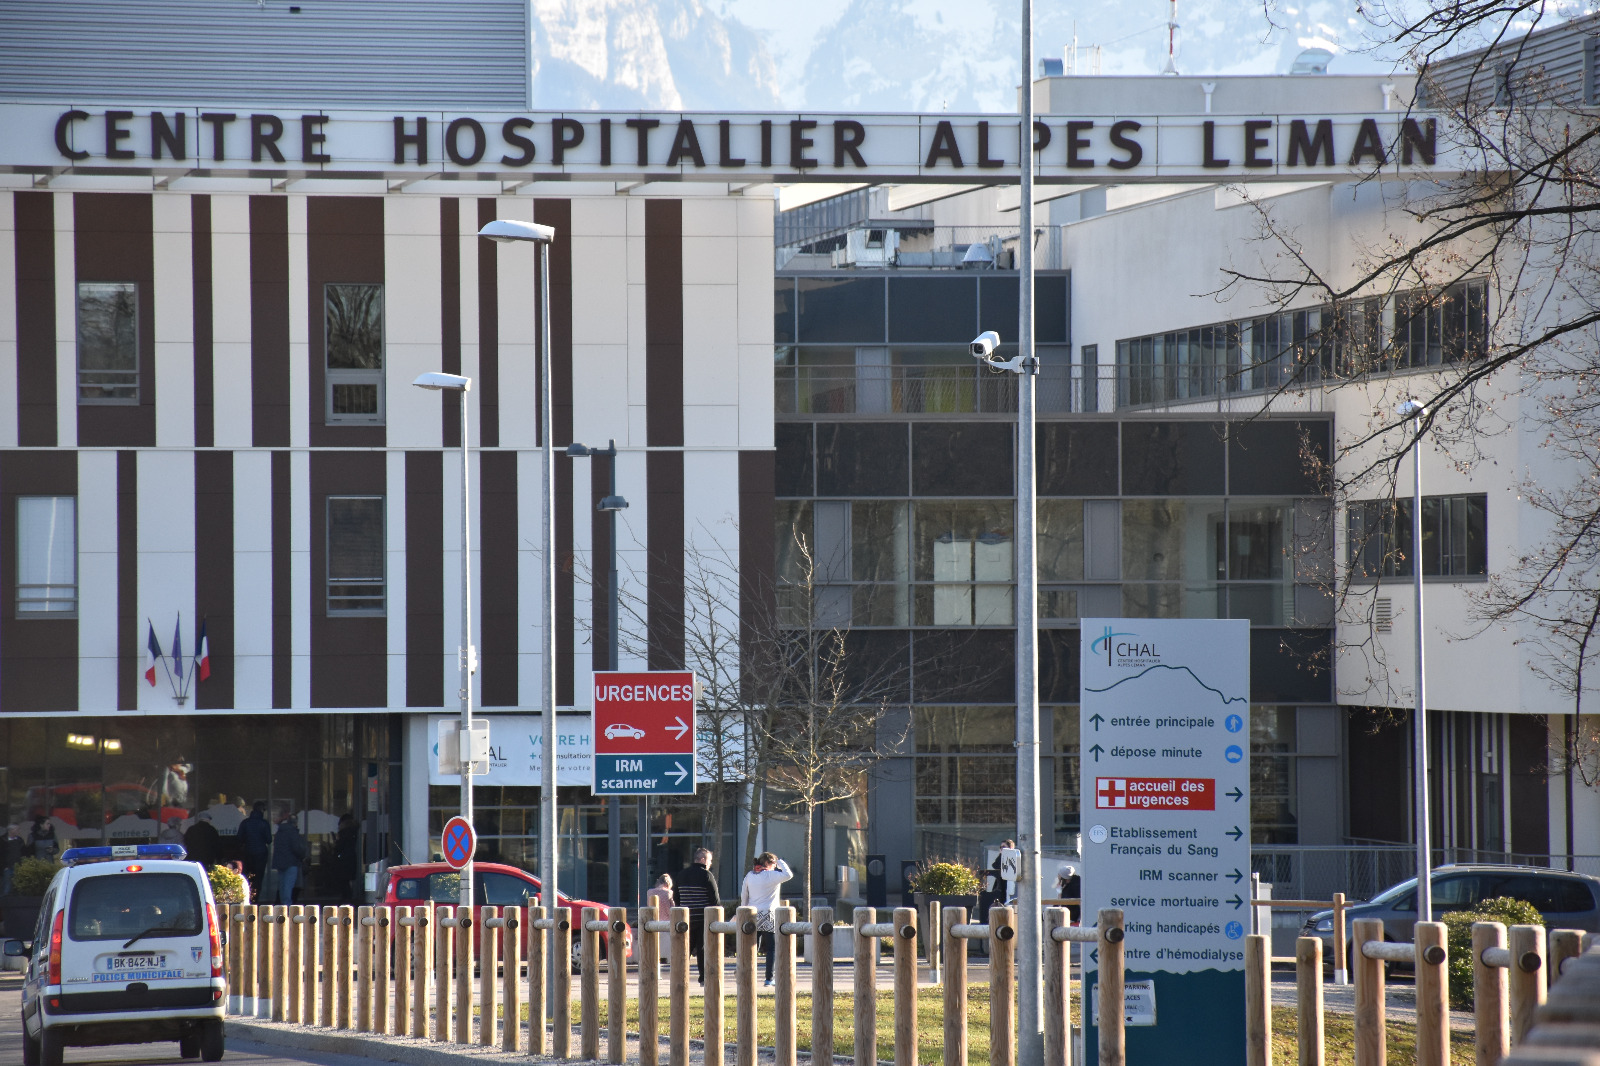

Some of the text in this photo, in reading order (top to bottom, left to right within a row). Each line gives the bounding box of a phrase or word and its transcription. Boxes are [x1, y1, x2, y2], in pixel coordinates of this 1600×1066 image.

[54, 110, 1437, 170] CENTRE HOSPITALIER ALPES LEMAN
[1116, 642, 1161, 657] CHAL
[595, 684, 693, 702] URGENCES
[1110, 715, 1215, 729] entrée principale
[529, 734, 576, 746] VRE
[1110, 746, 1203, 759] dépose minute
[615, 759, 643, 772] IRM
[601, 778, 658, 789] scanner
[1129, 780, 1205, 792] accueil des
[1129, 795, 1190, 807] urgences
[1110, 827, 1198, 839] Etablissement
[1110, 843, 1219, 858] Français du Sang
[1139, 869, 1219, 881] IRM scanner
[1110, 896, 1219, 907] service mortuaire
[1124, 921, 1220, 936] rking handicapés
[1156, 948, 1244, 962] d'hémodialyse
[114, 957, 159, 968] BK-842-NJ
[93, 973, 126, 983] POLICE
[127, 970, 182, 980] MUNICIPALE
